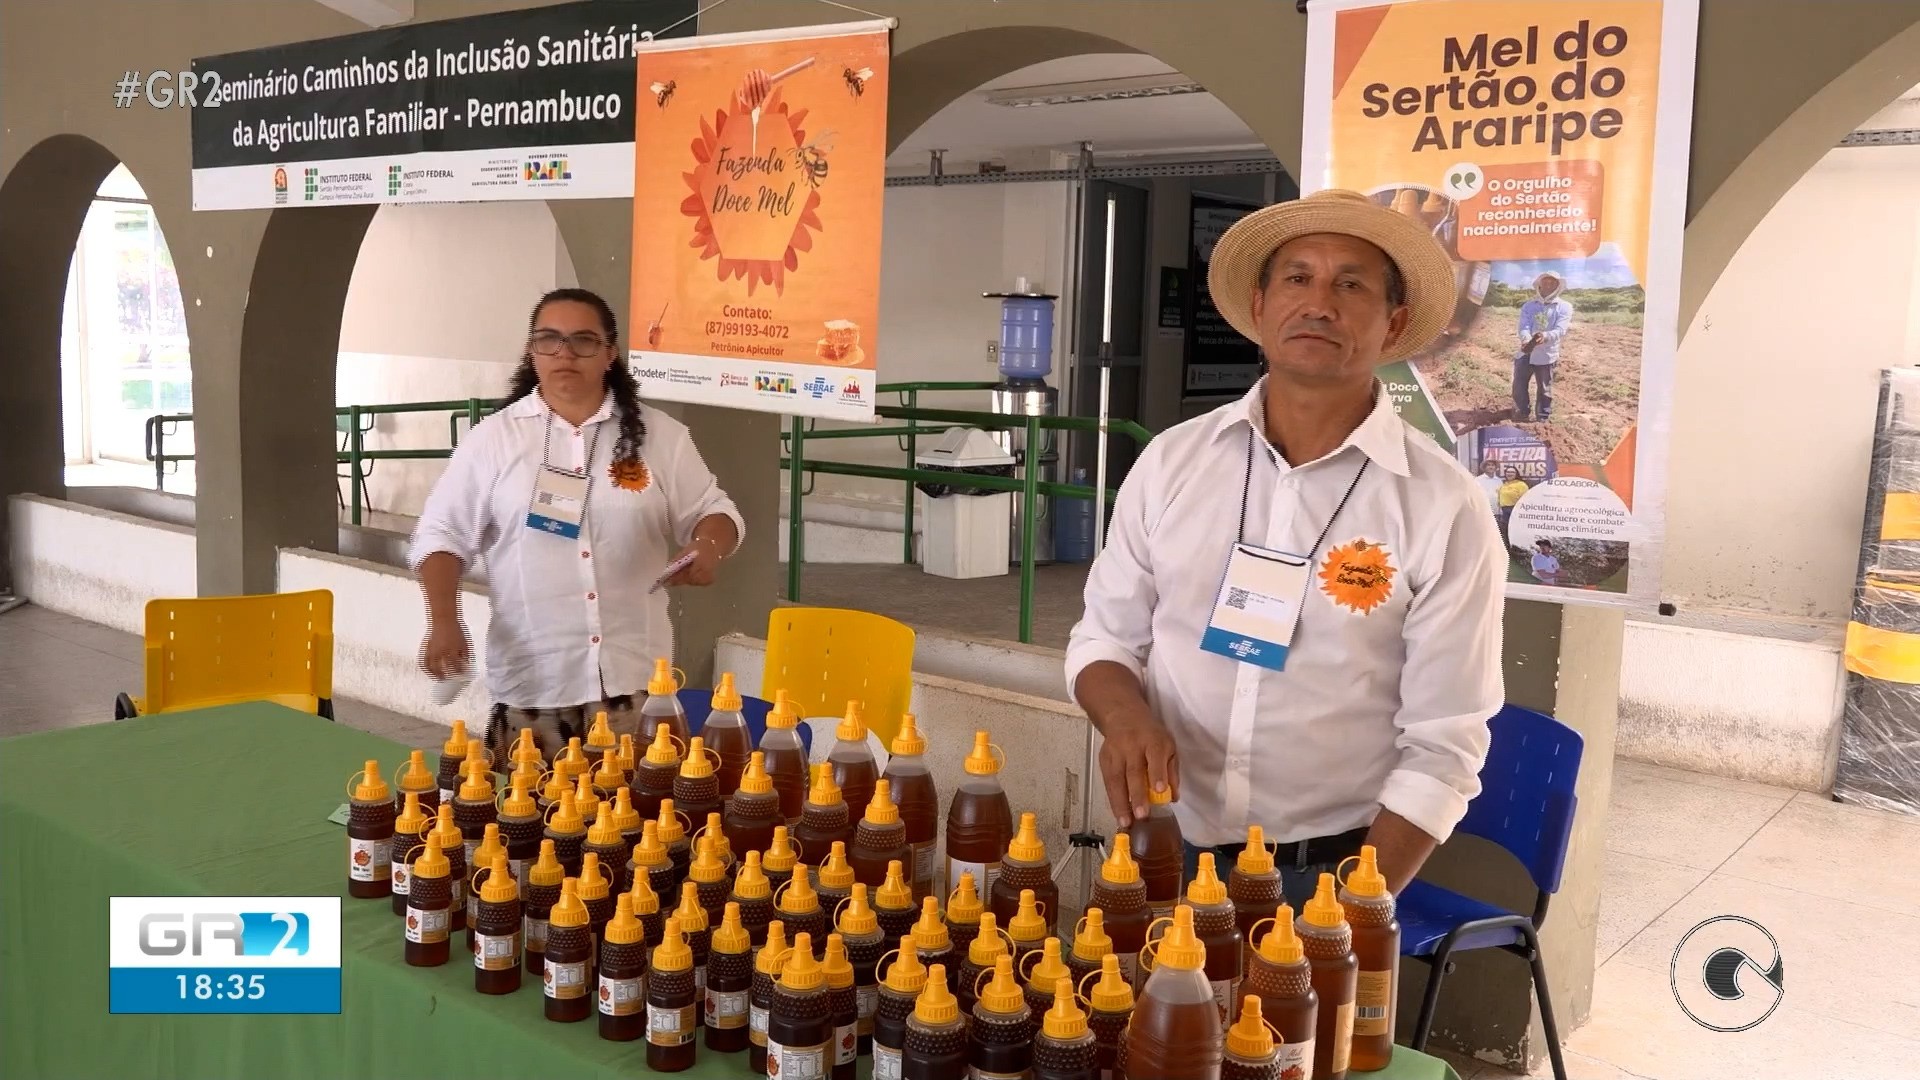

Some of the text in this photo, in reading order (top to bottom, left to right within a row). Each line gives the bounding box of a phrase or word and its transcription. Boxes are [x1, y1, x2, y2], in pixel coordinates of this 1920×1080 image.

[1443, 20, 1628, 74] Mel do
[303, 56, 399, 93] Caminhos
[404, 50, 429, 81] da
[436, 38, 531, 77] Inclusão
[1362, 60, 1626, 119] Sertão do
[233, 89, 621, 152] da Agricultura Familiar - Pernambuco
[1411, 102, 1624, 156] Araripe
[716, 146, 785, 181] Fazenda
[320, 172, 373, 184] INSTITUTO FEDERAL
[426, 169, 454, 178] FEDERAL
[1488, 175, 1572, 193] O Orgulho
[712, 181, 796, 218] Doce Mel
[1490, 191, 1570, 206] do Sertão
[1478, 205, 1583, 221] reconhecido
[1463, 219, 1597, 237] nacionalmente!
[723, 304, 772, 320] Contato:
[705, 321, 789, 339] (87)99193-4072
[711, 341, 784, 356] Petrônio Apicultor
[633, 366, 667, 379] Prodeter
[803, 382, 835, 394] SEBRAE
[1389, 382, 1419, 392] Doce
[1519, 502, 1625, 517] Apicultura agroecológica
[1518, 512, 1554, 521] aumenta
[1556, 514, 1578, 523] lucro
[1587, 516, 1625, 526] combate
[1527, 522, 1615, 535] mudanças climáticas
